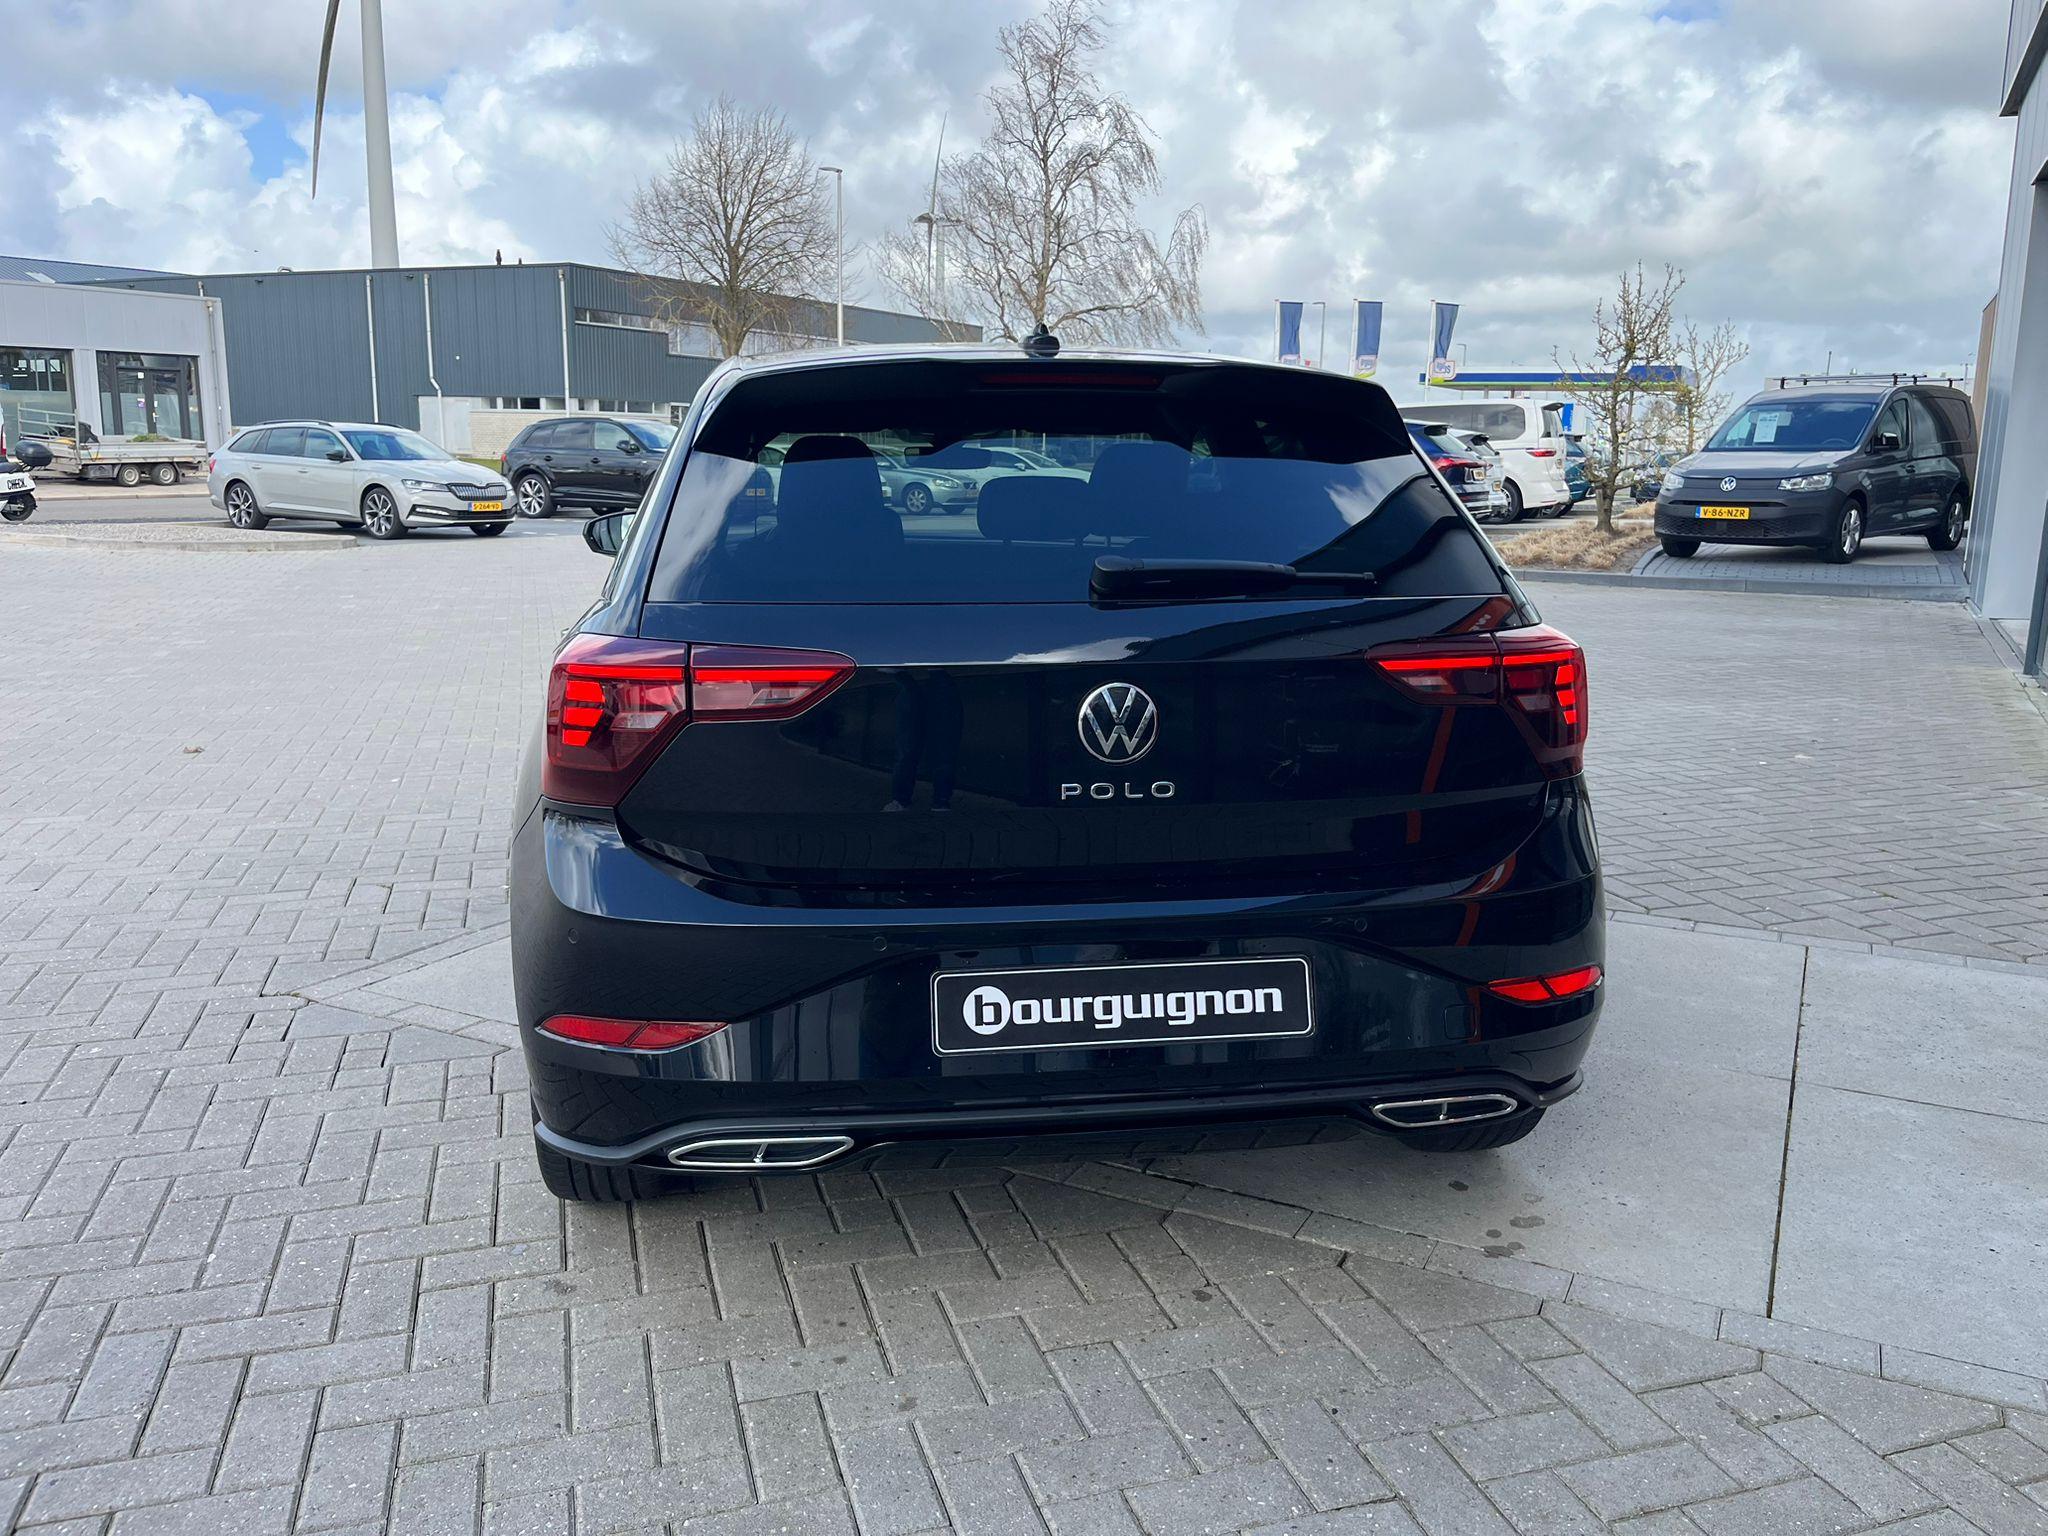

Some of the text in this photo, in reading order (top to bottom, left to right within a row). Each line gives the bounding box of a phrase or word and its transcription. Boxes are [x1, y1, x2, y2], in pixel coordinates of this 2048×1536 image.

[1702, 508, 1746, 518] V-86-NZR
[1061, 781, 1175, 800] POLO
[963, 986, 1283, 1035] bourguignon
